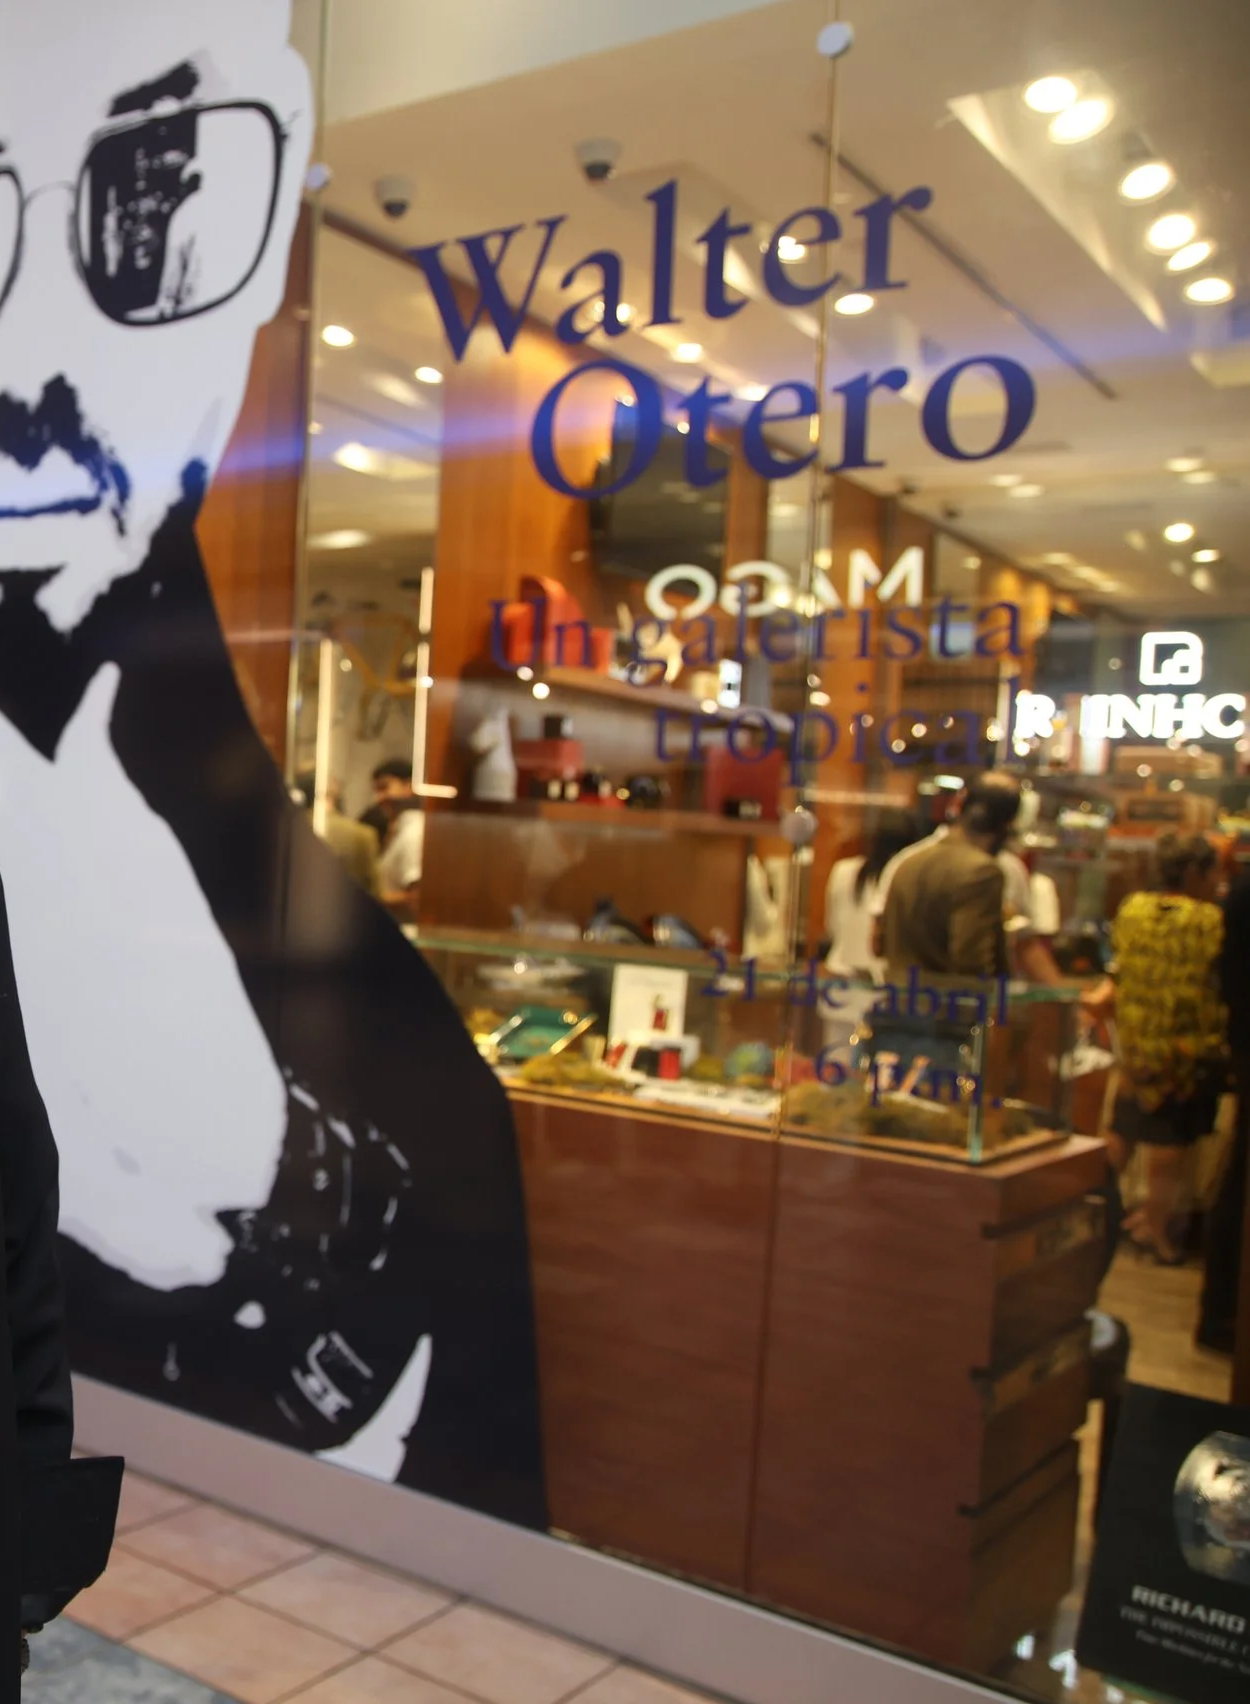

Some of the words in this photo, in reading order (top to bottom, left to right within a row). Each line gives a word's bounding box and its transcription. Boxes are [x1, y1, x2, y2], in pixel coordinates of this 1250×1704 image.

[407, 180, 932, 363] Walter
[531, 355, 1037, 500] Otero
[489, 596, 597, 672] Un
[628, 580, 1025, 687] galerista
[653, 680, 1024, 788] tropical
[702, 949, 757, 1001] 21
[788, 958, 851, 1010] de
[873, 964, 1009, 1026] abril
[814, 1041, 848, 1086] 6
[1131, 1585, 1245, 1635] RICHARD
